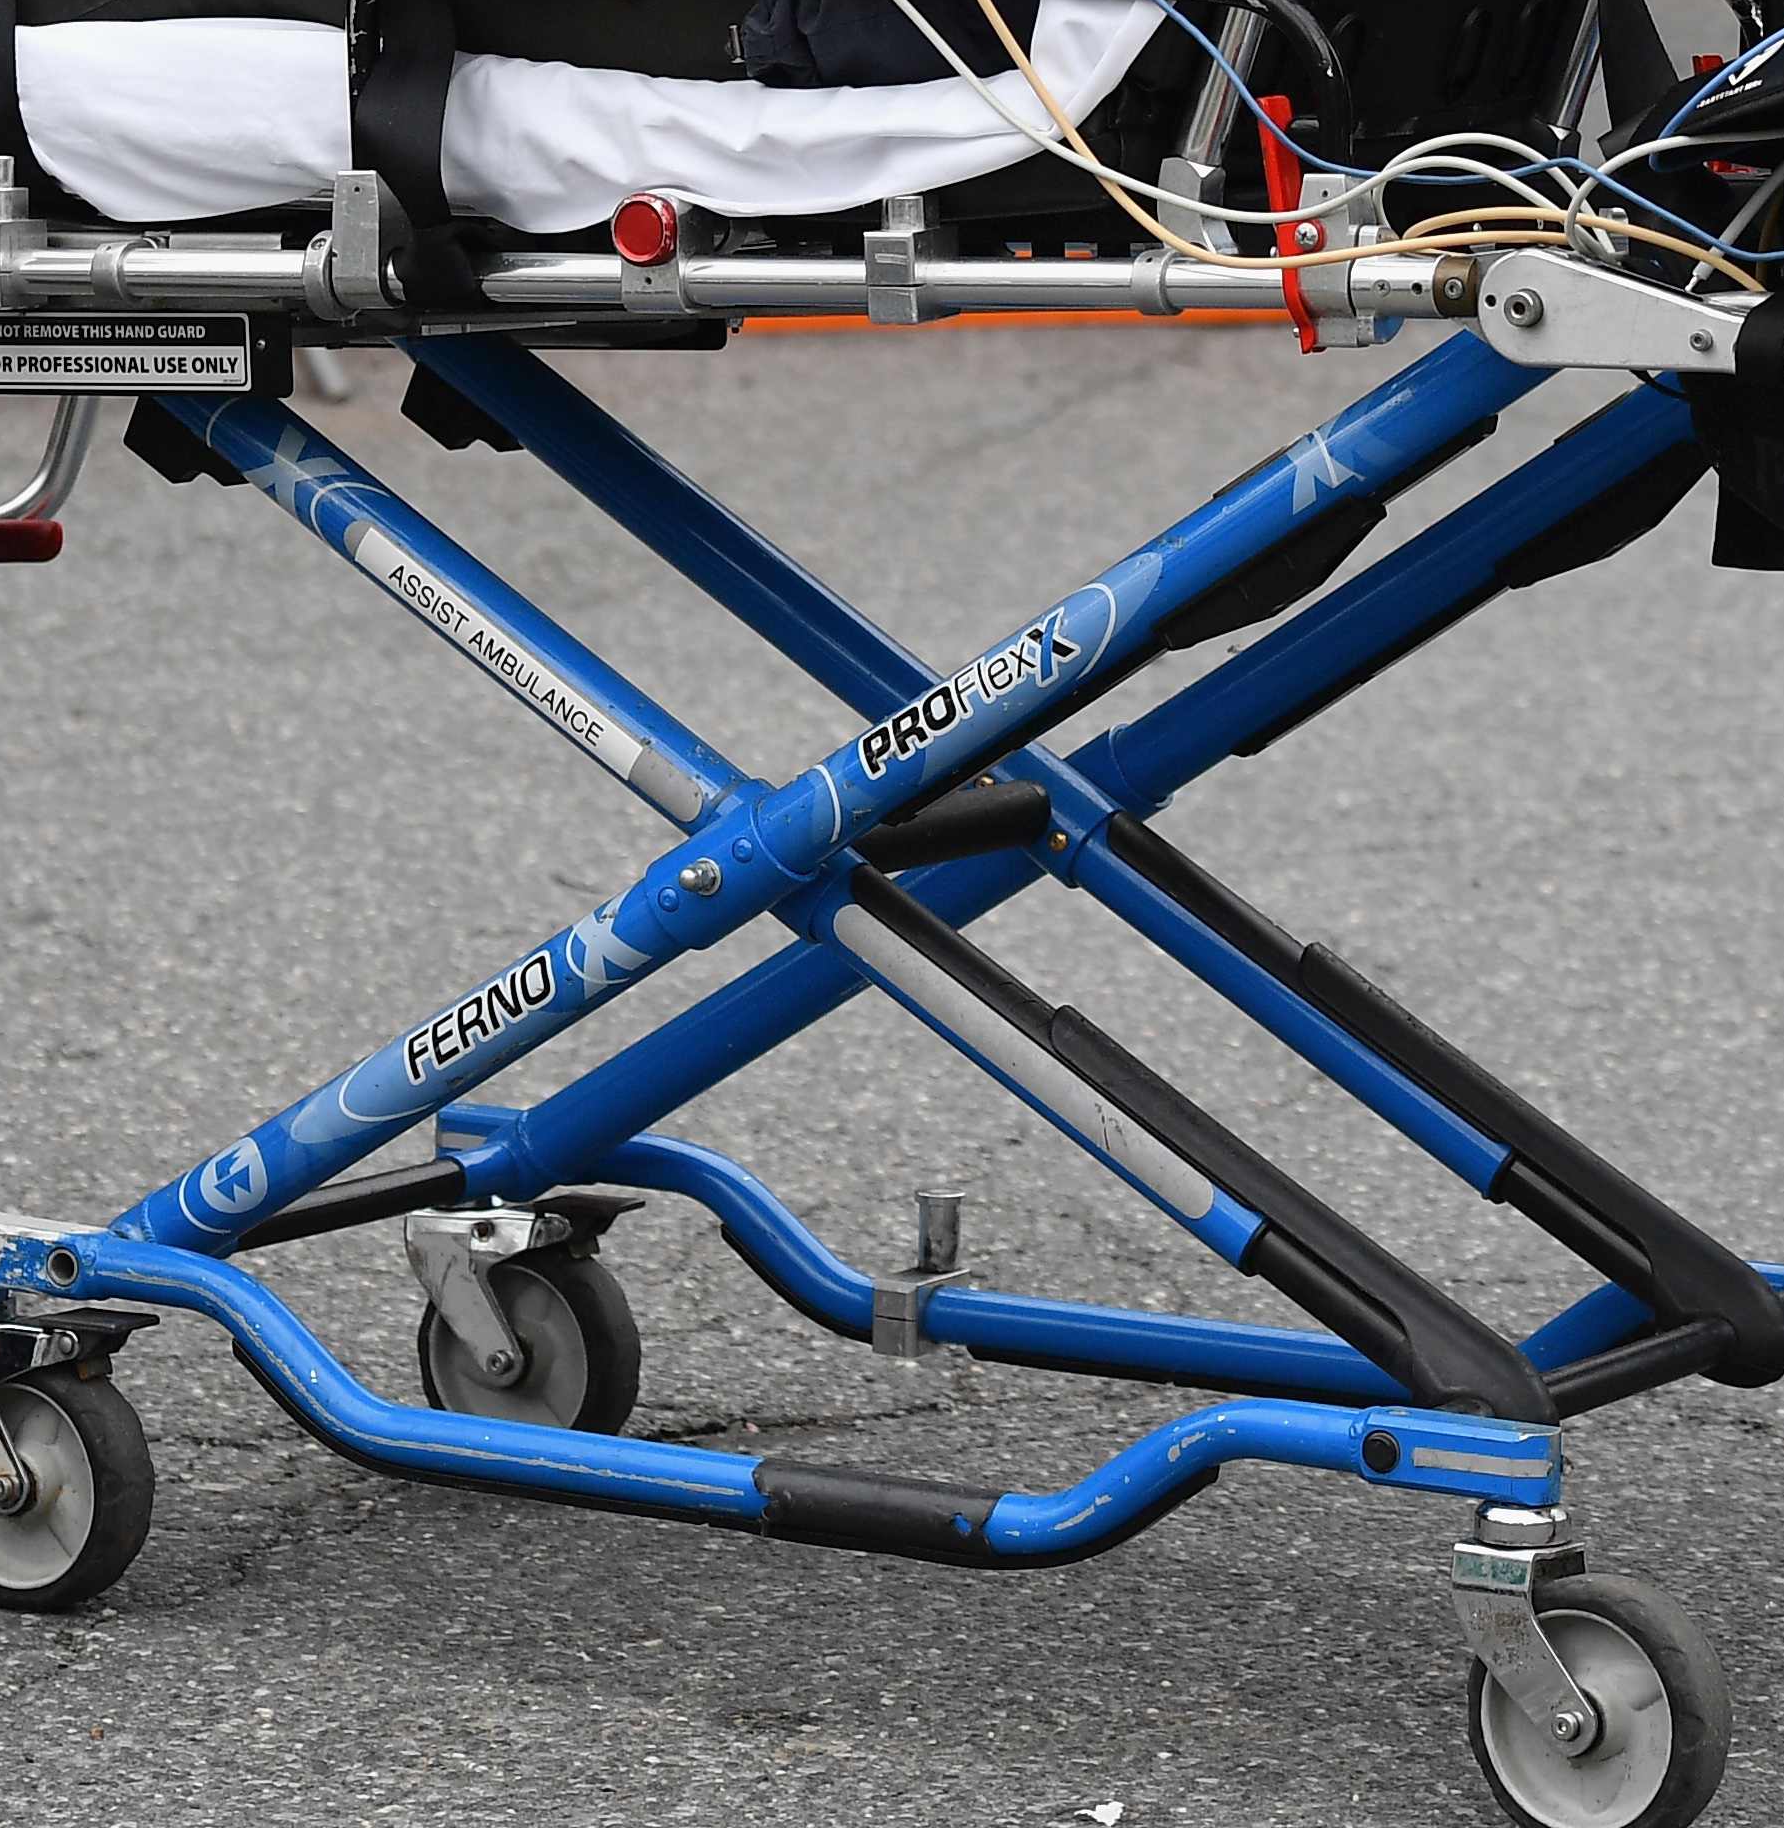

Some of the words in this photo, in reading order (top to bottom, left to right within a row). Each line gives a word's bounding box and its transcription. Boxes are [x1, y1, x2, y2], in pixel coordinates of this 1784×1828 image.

[17, 356, 150, 374] PROFESSIONAL
[153, 356, 188, 374] USE
[191, 356, 239, 374] ONLY
[23, 324, 80, 339] REMOVE
[81, 325, 112, 339] THIS
[115, 325, 155, 339] HAND
[157, 325, 206, 339] GUARD
[388, 564, 469, 633] ASSIST
[467, 629, 604, 747] AMBULANCE
[406, 954, 553, 1081] FERNO
